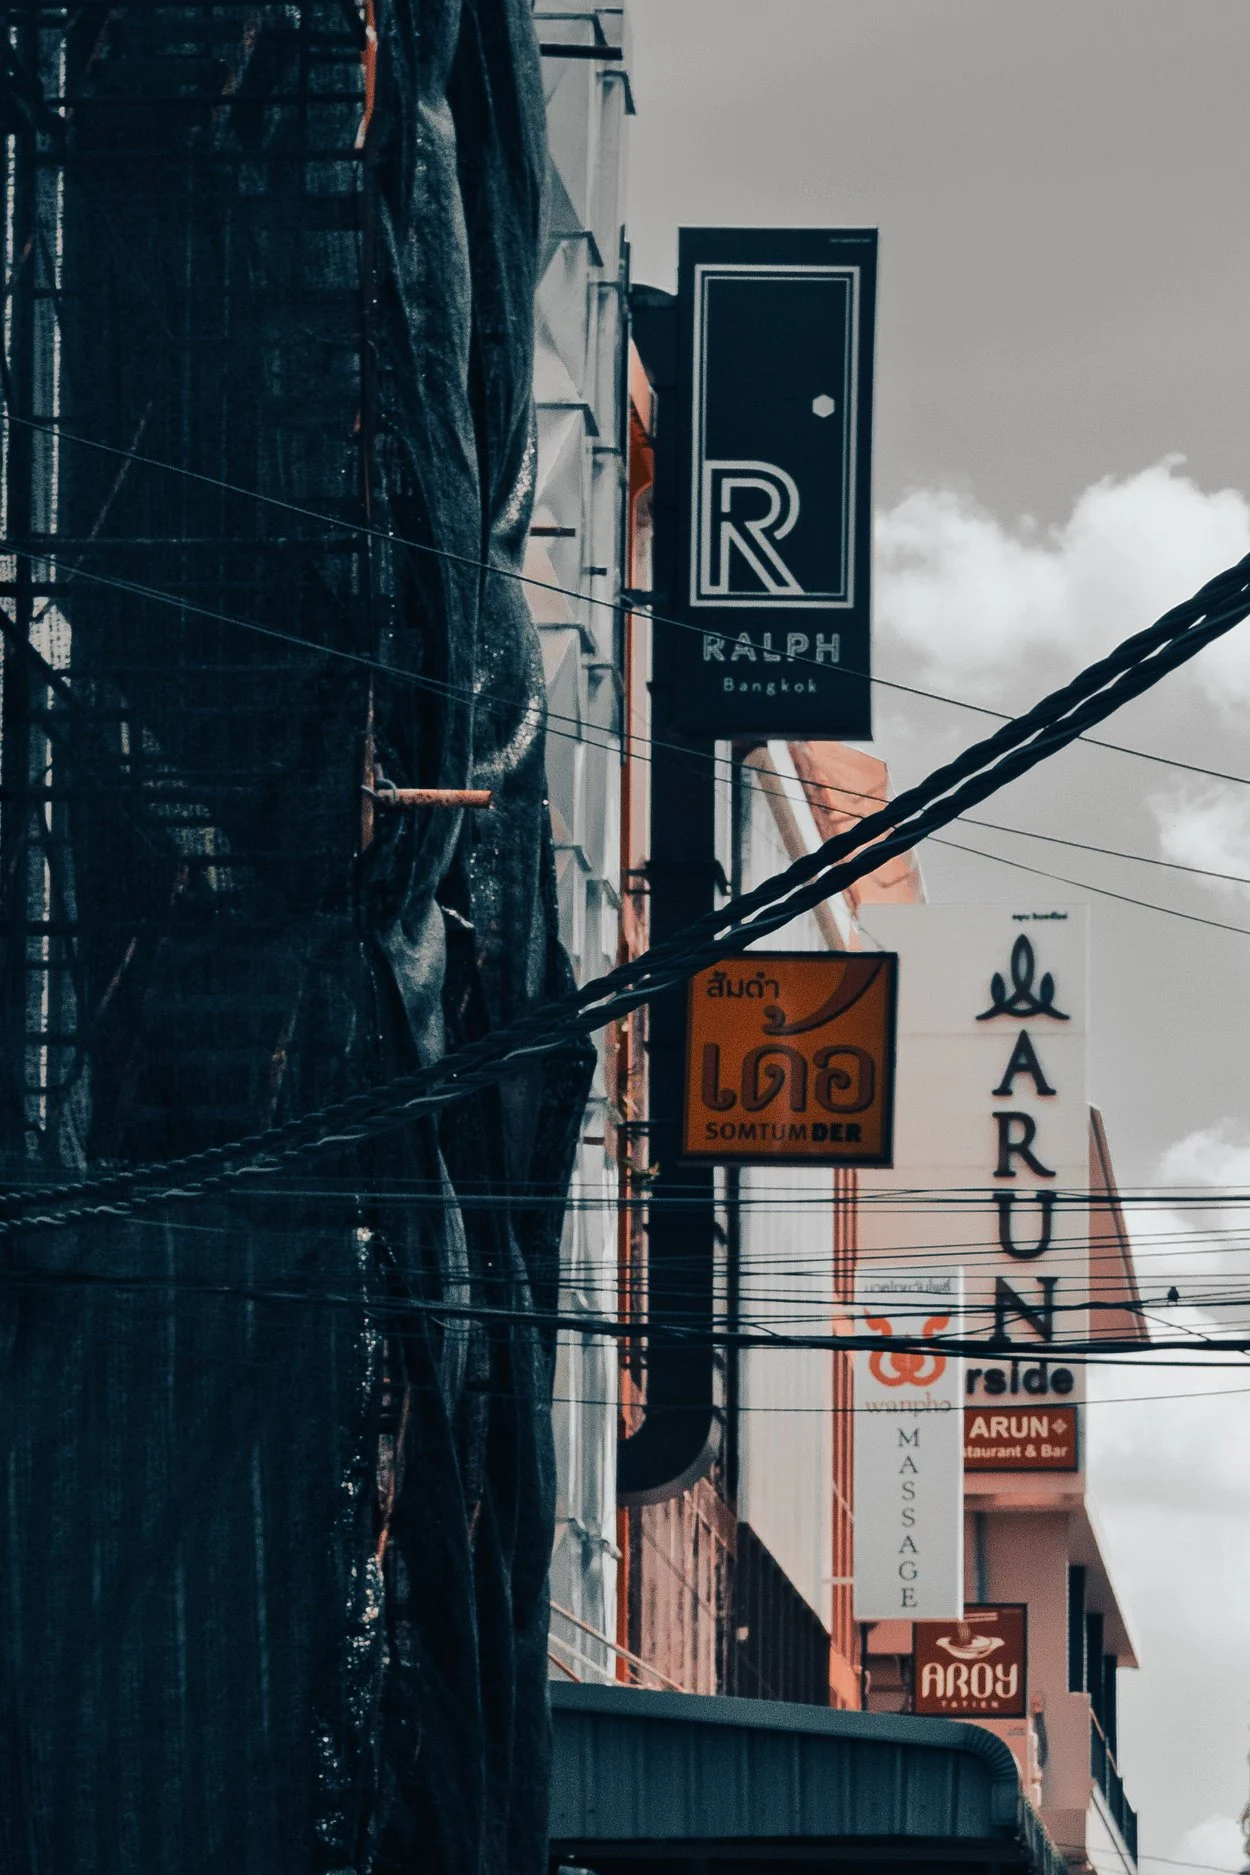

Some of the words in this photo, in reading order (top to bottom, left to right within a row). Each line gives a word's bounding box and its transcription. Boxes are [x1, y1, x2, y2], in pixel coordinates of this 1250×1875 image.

[702, 632, 841, 663] RALPH
[723, 677, 818, 695] Bangkok
[706, 1122, 806, 1142] SOMTUM
[811, 1122, 862, 1142] DER
[969, 1416, 1048, 1438] ARUN
[964, 1445, 1021, 1457] taurant
[1025, 1445, 1036, 1457] &
[1041, 1445, 1068, 1457] Bar
[898, 1428, 920, 1608] MASSAGE
[921, 1662, 1018, 1698] AROY
